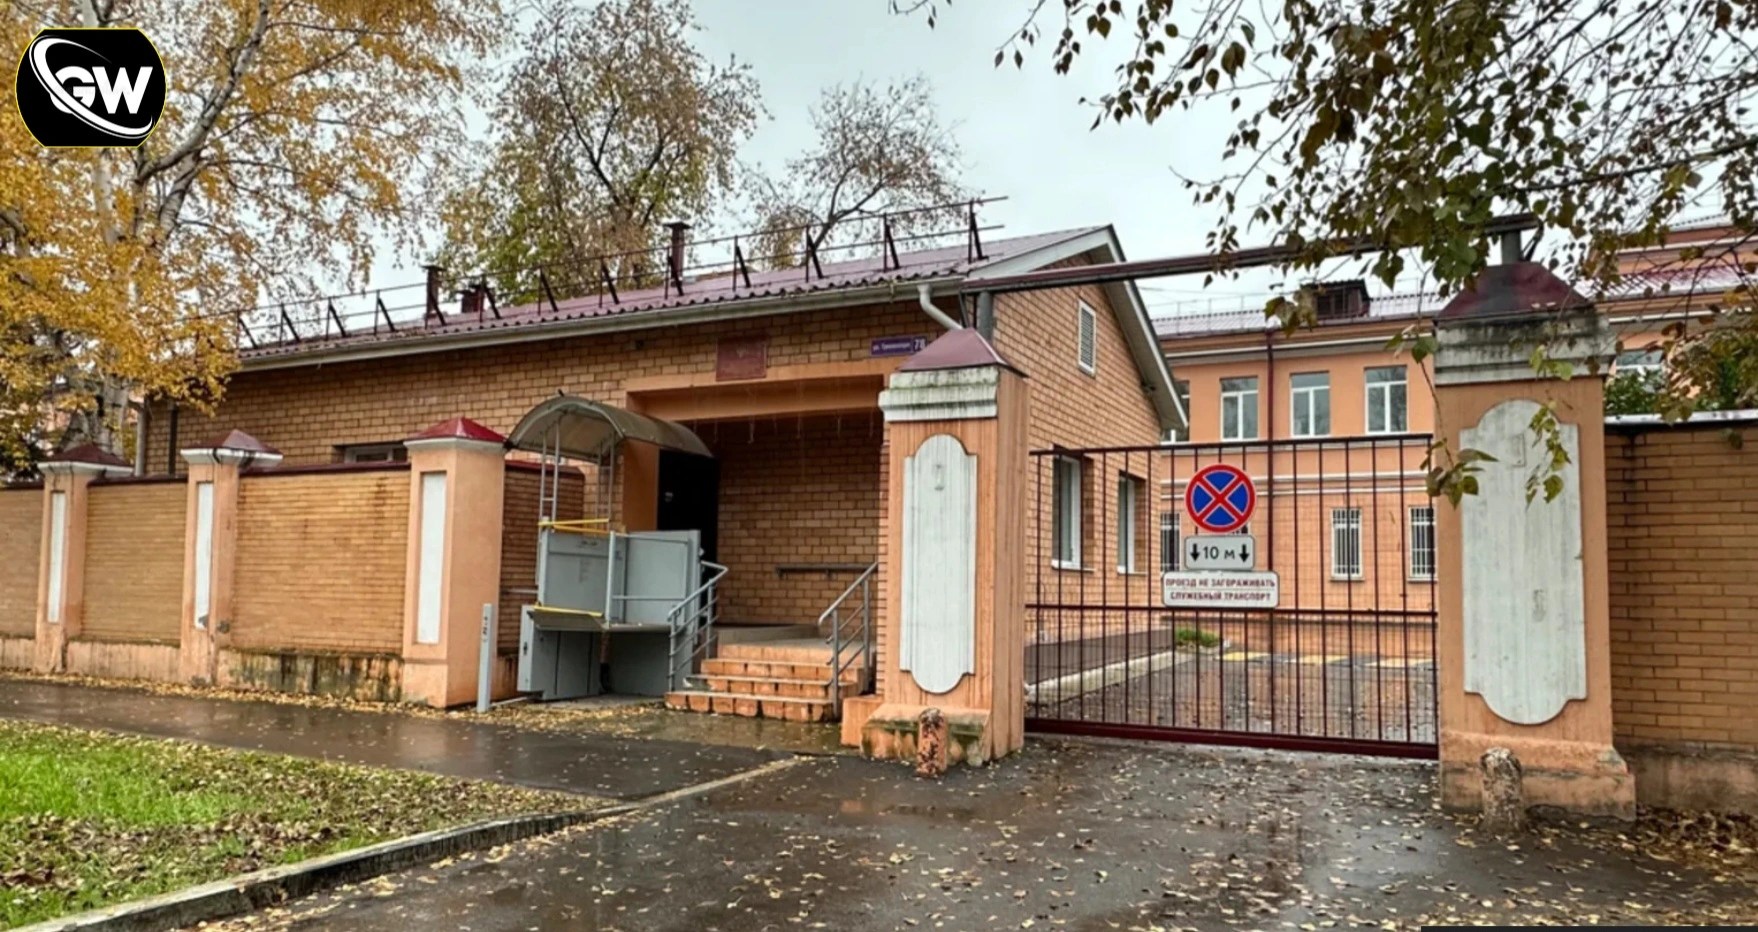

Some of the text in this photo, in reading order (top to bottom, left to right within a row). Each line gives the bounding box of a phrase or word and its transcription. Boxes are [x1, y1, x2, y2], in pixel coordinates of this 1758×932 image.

[1203, 546, 1219, 559] 10
[1165, 578, 1275, 587] ПРОЕЗД НЕ ЗАГОРАЖИВАТЬ
[1170, 591, 1271, 601] СЛУЖЕБНЫЙ ТРАНСПОРТ
